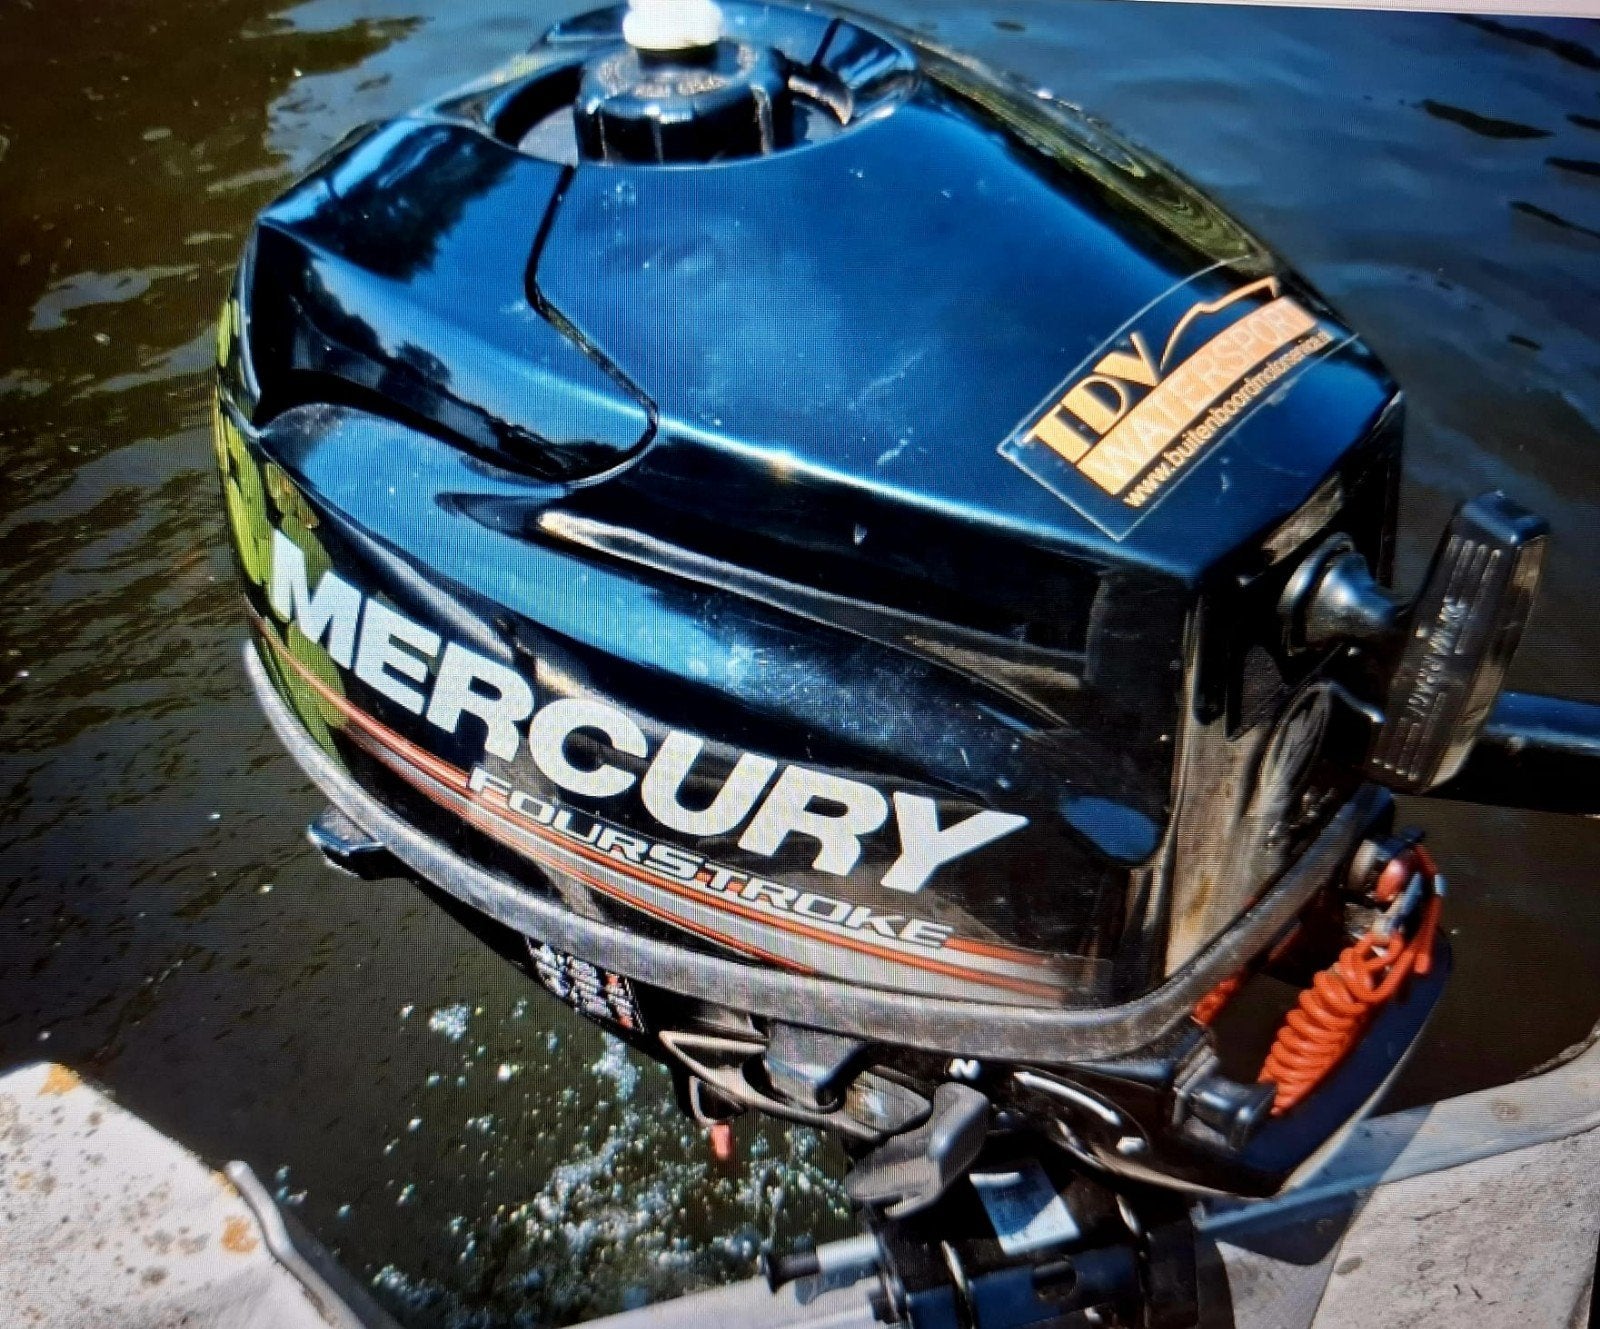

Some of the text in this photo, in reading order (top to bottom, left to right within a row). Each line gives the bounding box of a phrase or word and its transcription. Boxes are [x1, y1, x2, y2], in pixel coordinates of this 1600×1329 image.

[1019, 332, 1161, 464] TDV
[272, 529, 1028, 893] MERCURY
[467, 768, 955, 947] FOURSTROKE
